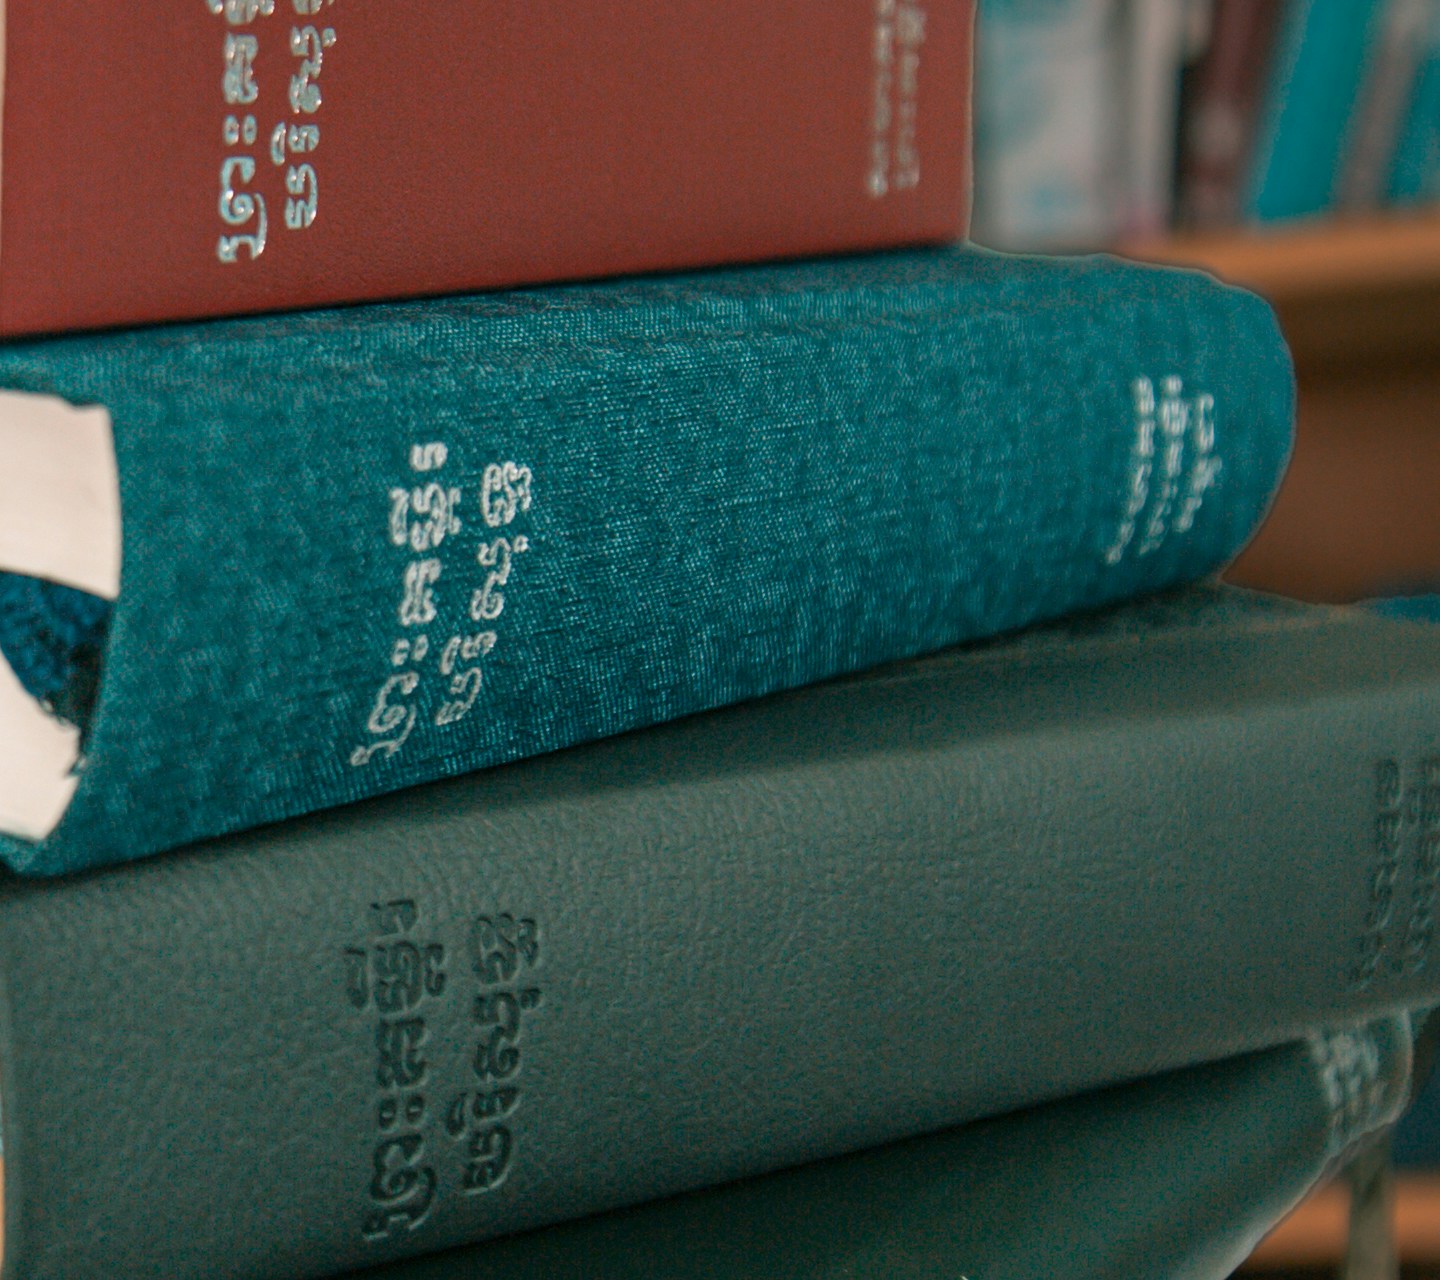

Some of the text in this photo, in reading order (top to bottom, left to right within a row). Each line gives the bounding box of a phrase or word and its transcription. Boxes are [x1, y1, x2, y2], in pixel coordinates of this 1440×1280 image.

[349, 441, 462, 767] ព្រះគម្ពីរ
[434, 460, 533, 727] បរិសុទ្ធ
[344, 898, 446, 1241] ព្រះគម្ពីរ
[444, 912, 542, 1195] បរិសុទ្ធ
